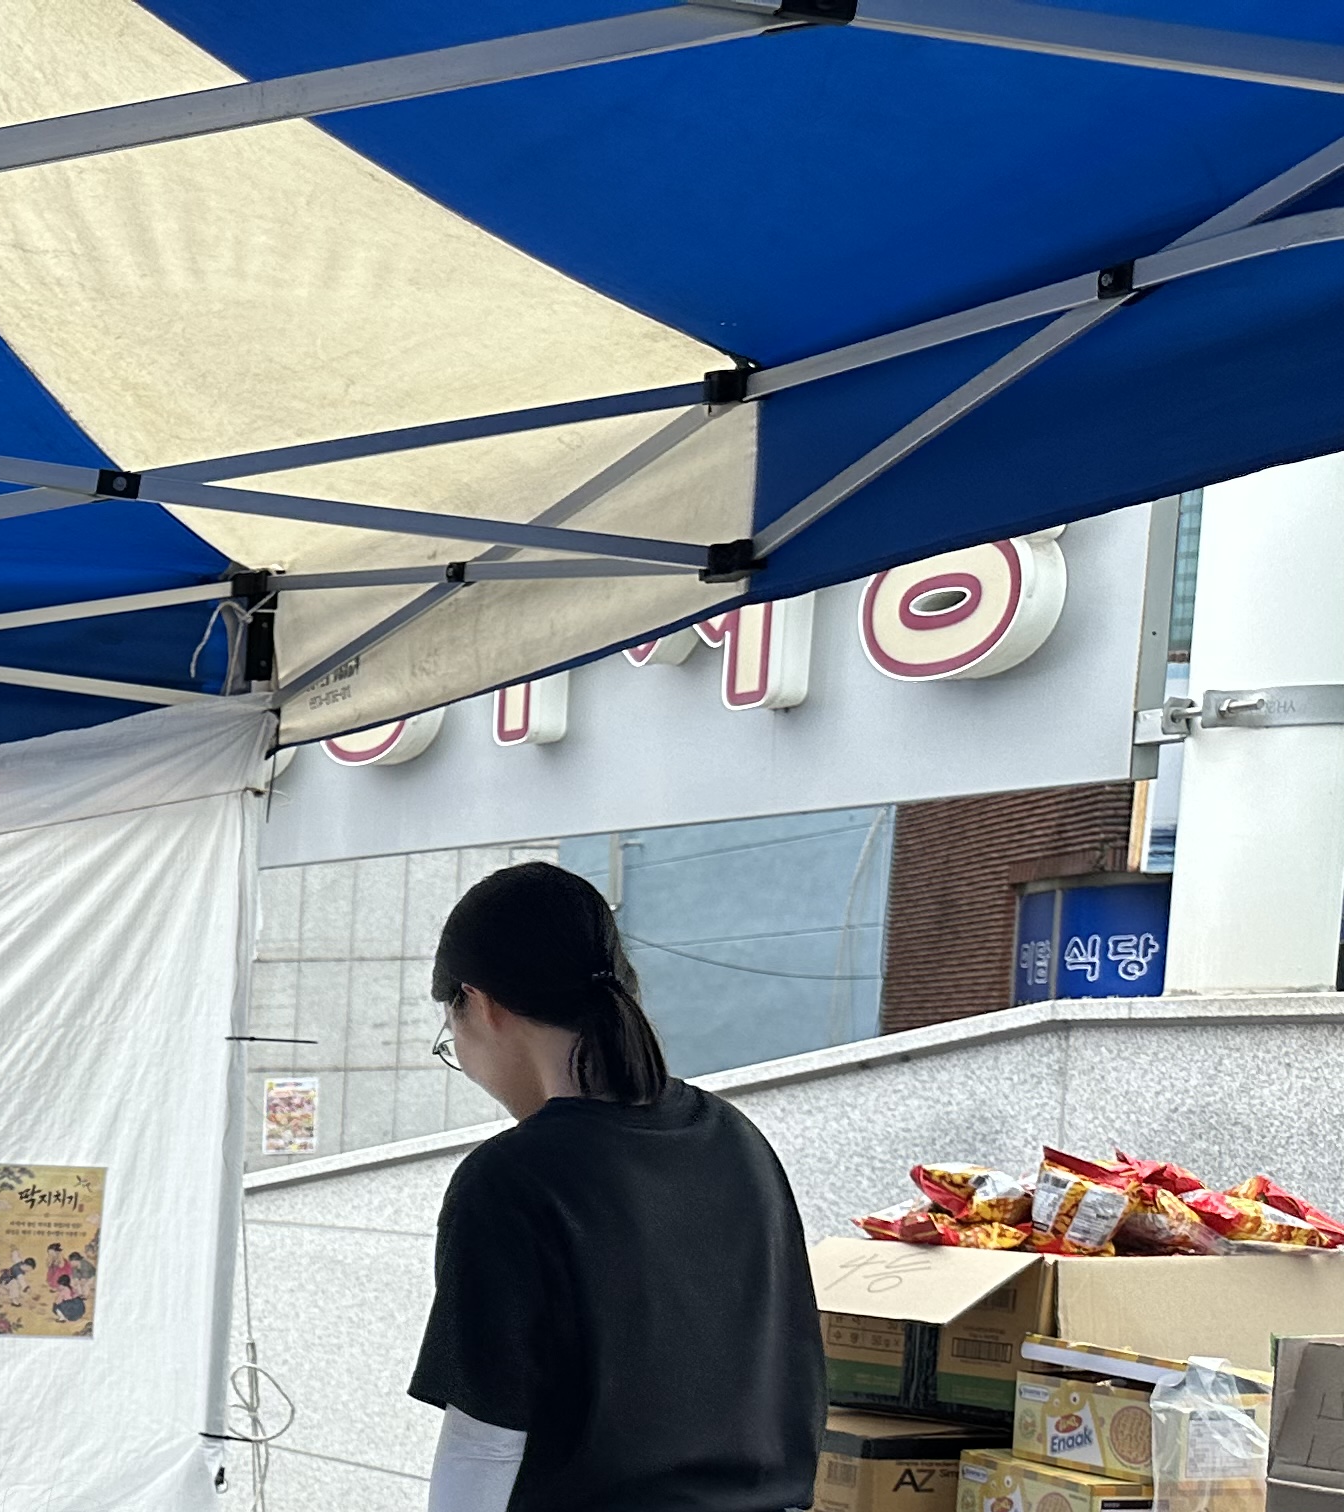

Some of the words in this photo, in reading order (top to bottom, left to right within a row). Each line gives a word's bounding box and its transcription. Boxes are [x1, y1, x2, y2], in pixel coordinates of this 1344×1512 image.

[1064, 932, 1160, 982] 식당
[17, 1184, 79, 1212] 딱지치기
[1050, 1425, 1093, 1454] Enaak
[892, 1469, 936, 1493] AZ
